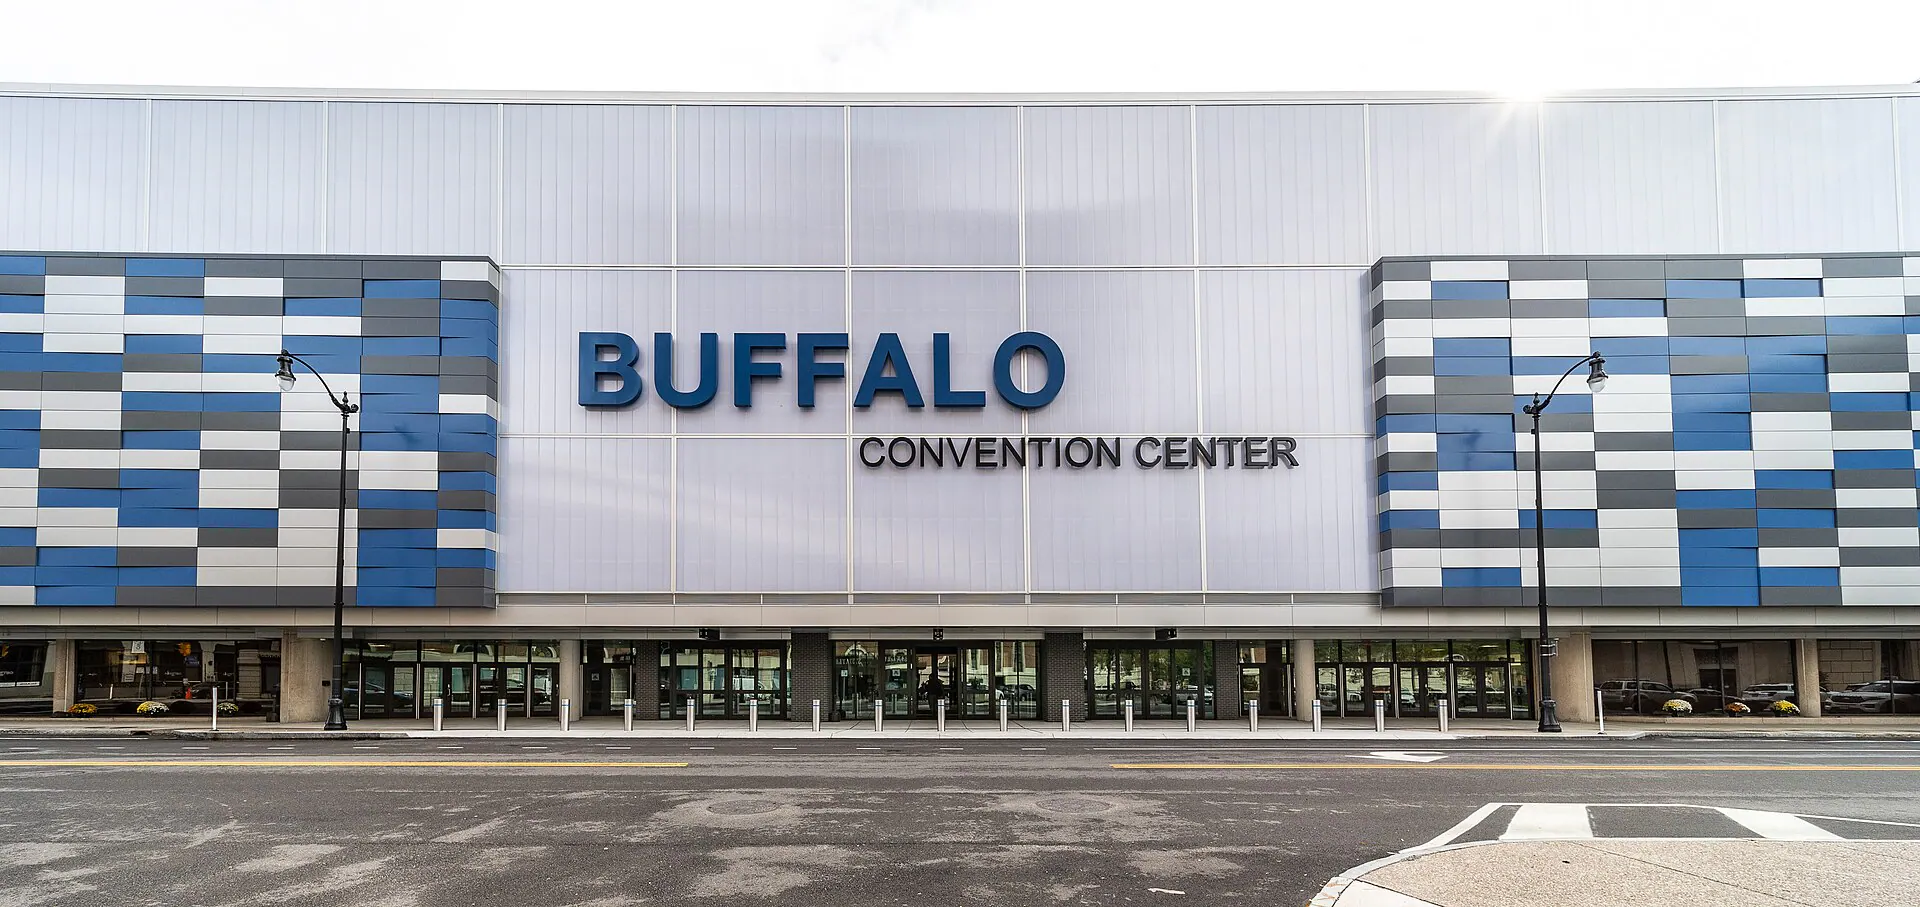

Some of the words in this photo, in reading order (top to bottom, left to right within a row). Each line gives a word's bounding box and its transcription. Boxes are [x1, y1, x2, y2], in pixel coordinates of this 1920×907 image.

[578, 331, 1066, 409] BUFFALO
[859, 437, 1121, 468] CONVENTION
[1134, 437, 1299, 468] CENTER
